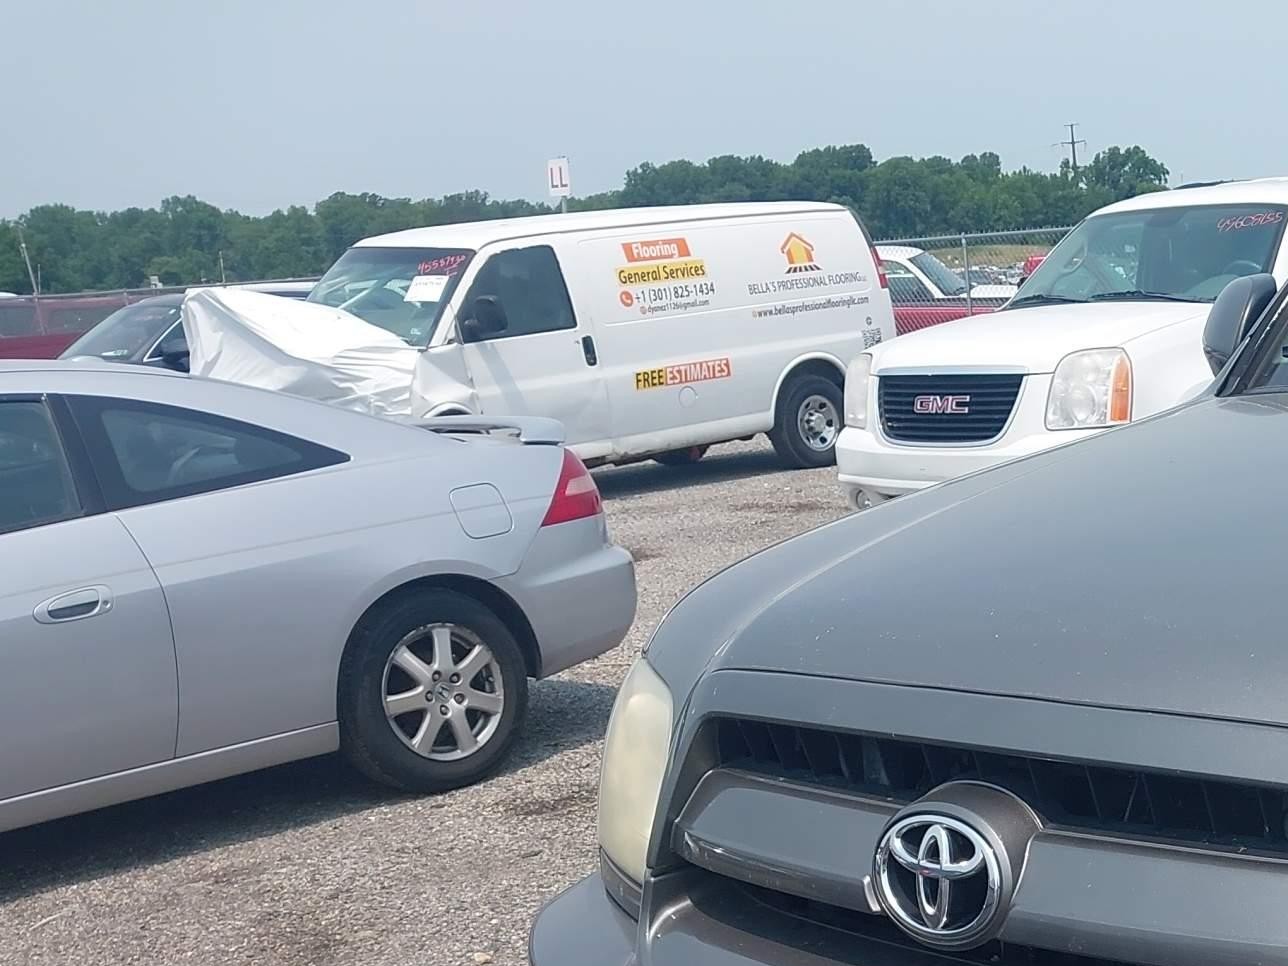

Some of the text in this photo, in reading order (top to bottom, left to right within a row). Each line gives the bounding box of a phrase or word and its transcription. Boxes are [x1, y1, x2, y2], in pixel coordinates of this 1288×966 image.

[549, 166, 569, 188] LL
[631, 241, 678, 258] Flooring
[618, 262, 705, 285] General Services
[776, 275, 828, 292] PROFESSIONAL
[827, 271, 862, 285] FLOORING
[635, 282, 715, 304] +1 (301) 825-1434
[635, 359, 729, 390] FREE ESTIMATES
[913, 395, 970, 415] GMC
